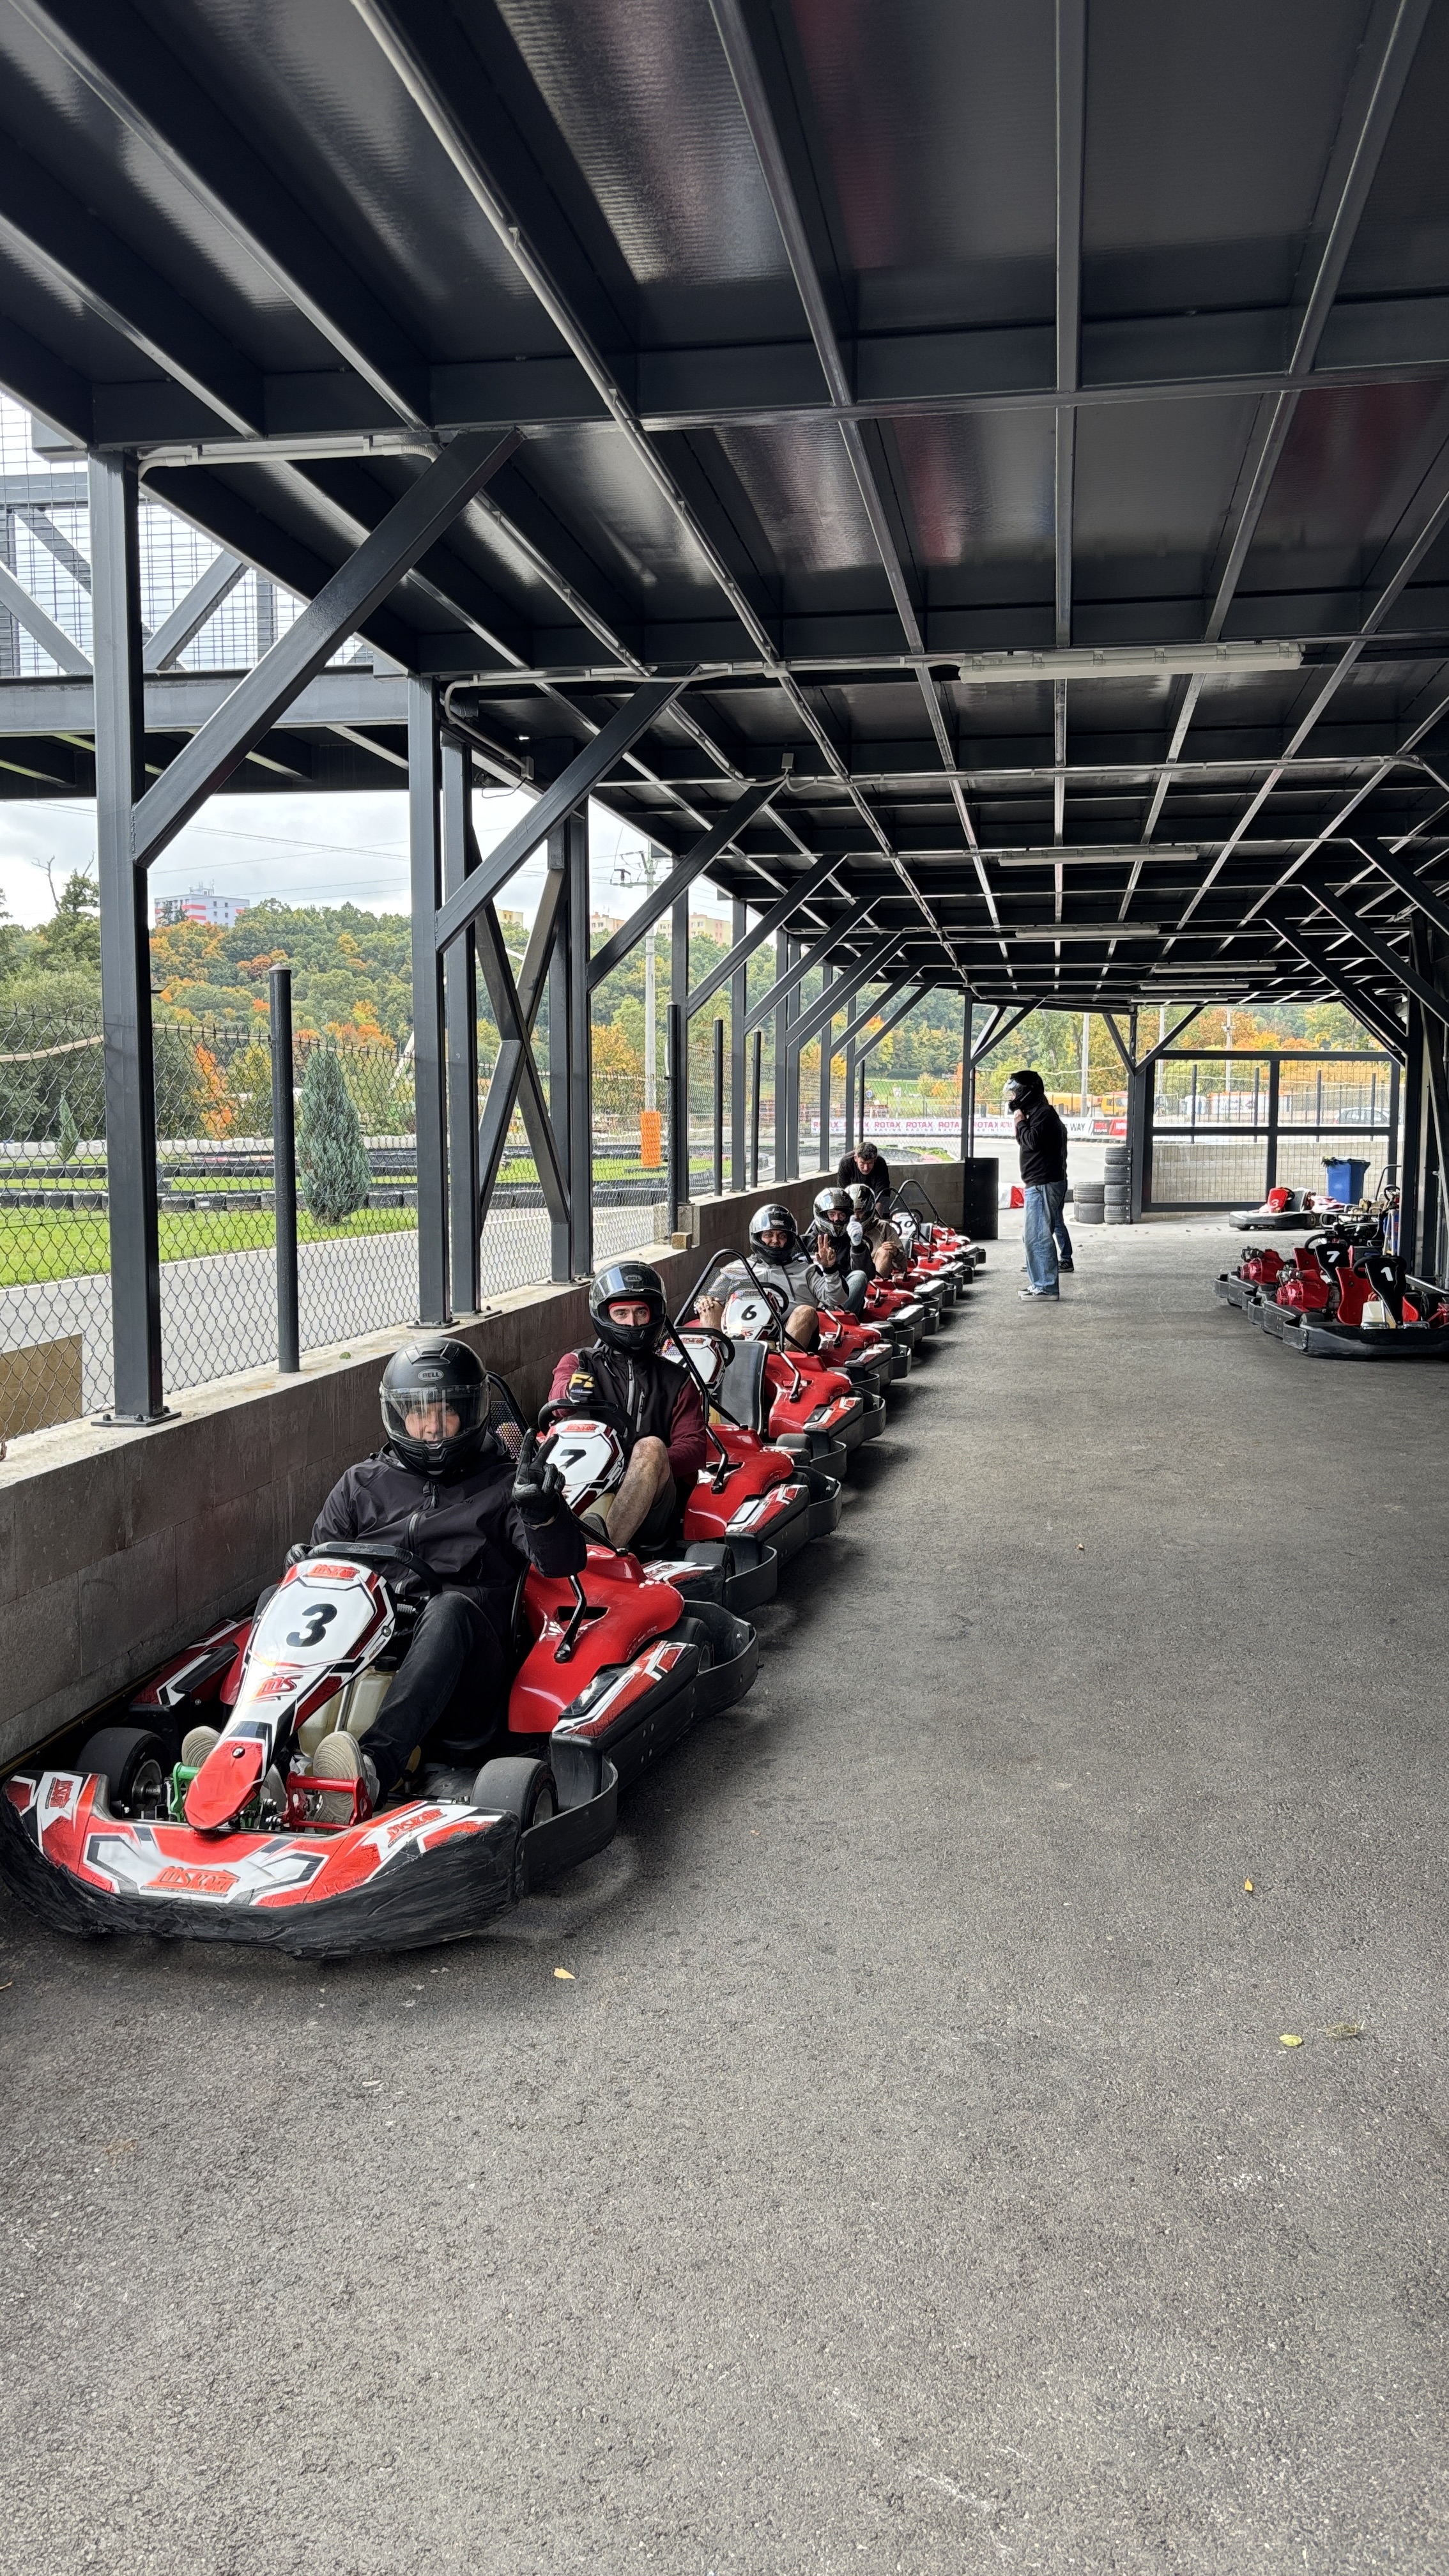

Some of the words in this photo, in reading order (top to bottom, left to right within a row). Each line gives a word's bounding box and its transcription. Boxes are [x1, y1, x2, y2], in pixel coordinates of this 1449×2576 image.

[1070, 1123, 1085, 1132] WAY
[1271, 1199, 1279, 1208] 3
[1326, 1250, 1340, 1262] 7
[1381, 1266, 1393, 1282] 1
[741, 1305, 757, 1321] 6
[559, 1448, 586, 1471] 7
[286, 1603, 337, 1647] 3
